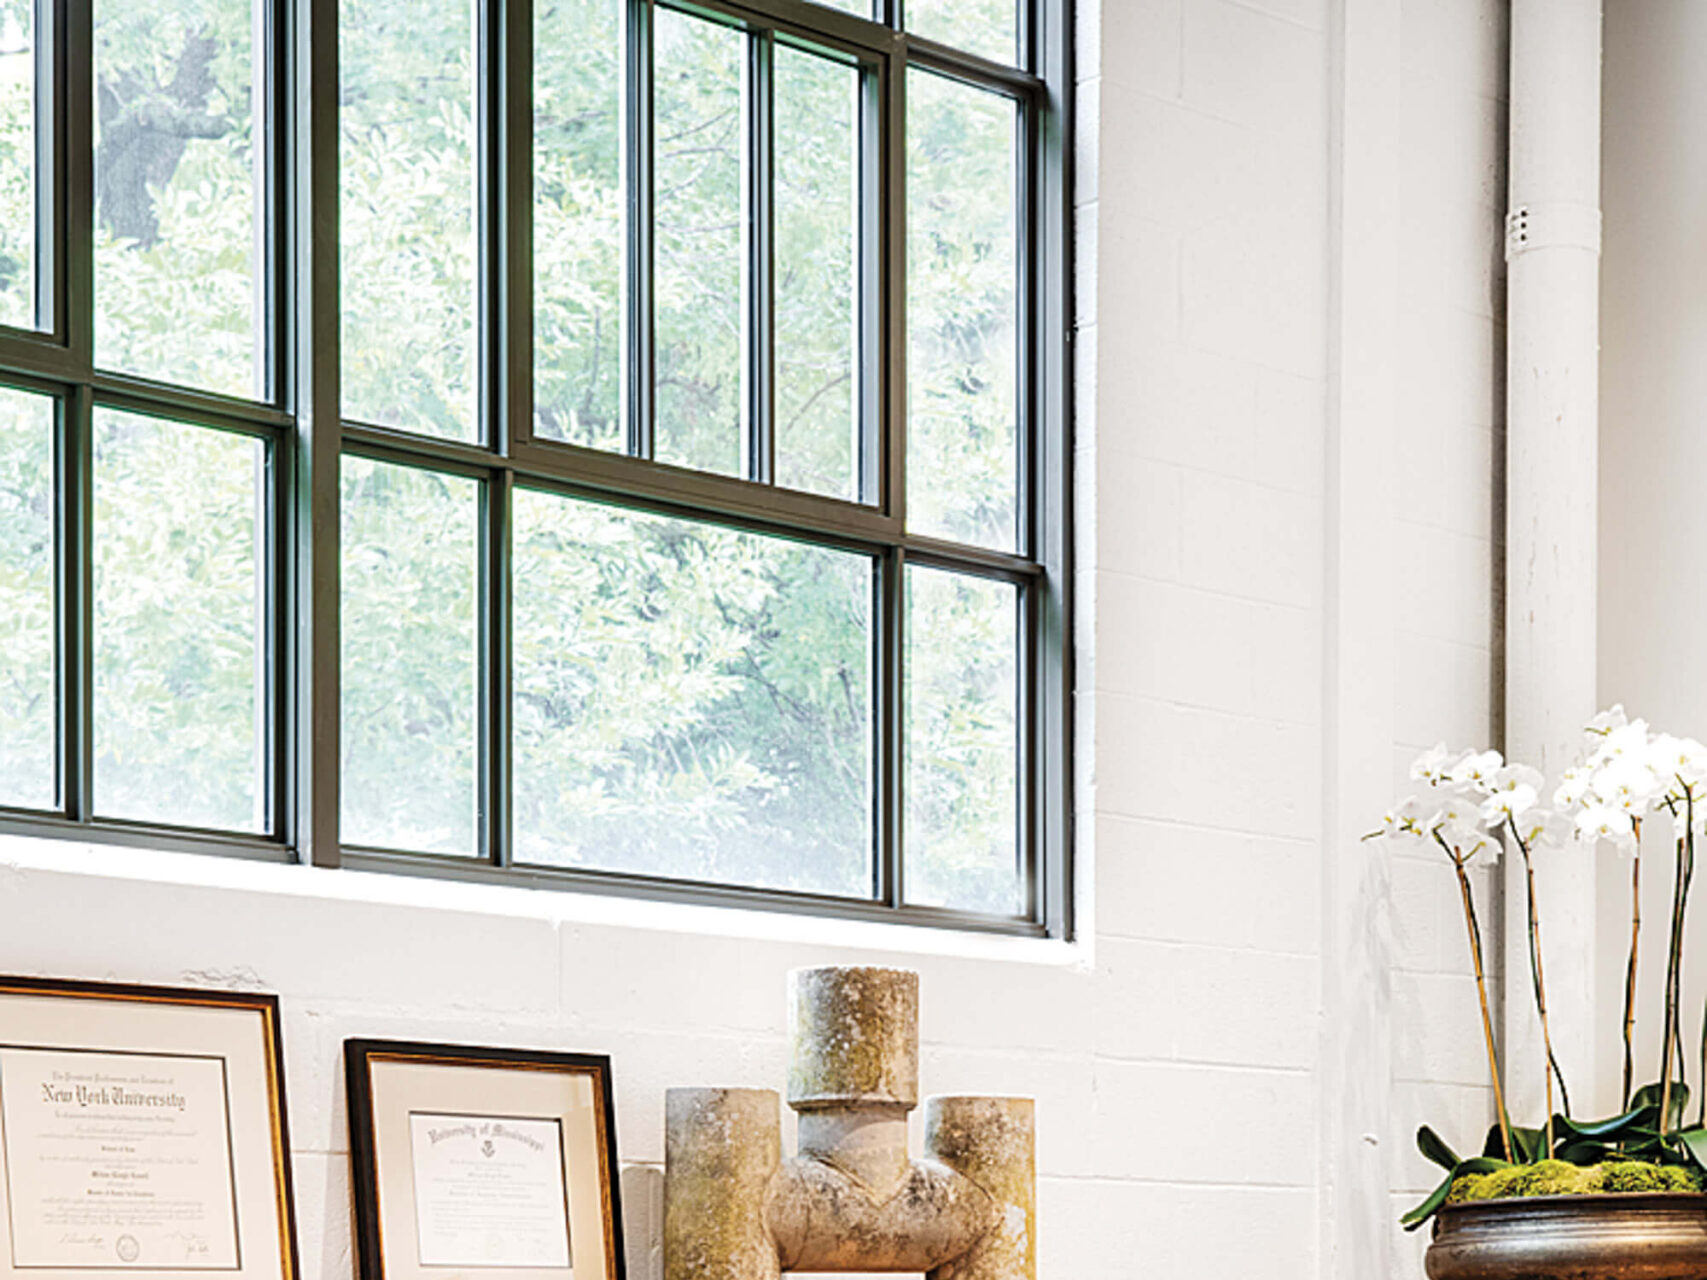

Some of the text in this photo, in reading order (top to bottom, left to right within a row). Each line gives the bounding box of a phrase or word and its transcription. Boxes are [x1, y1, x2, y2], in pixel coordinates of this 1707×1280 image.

[42, 1083, 186, 1111] New York University
